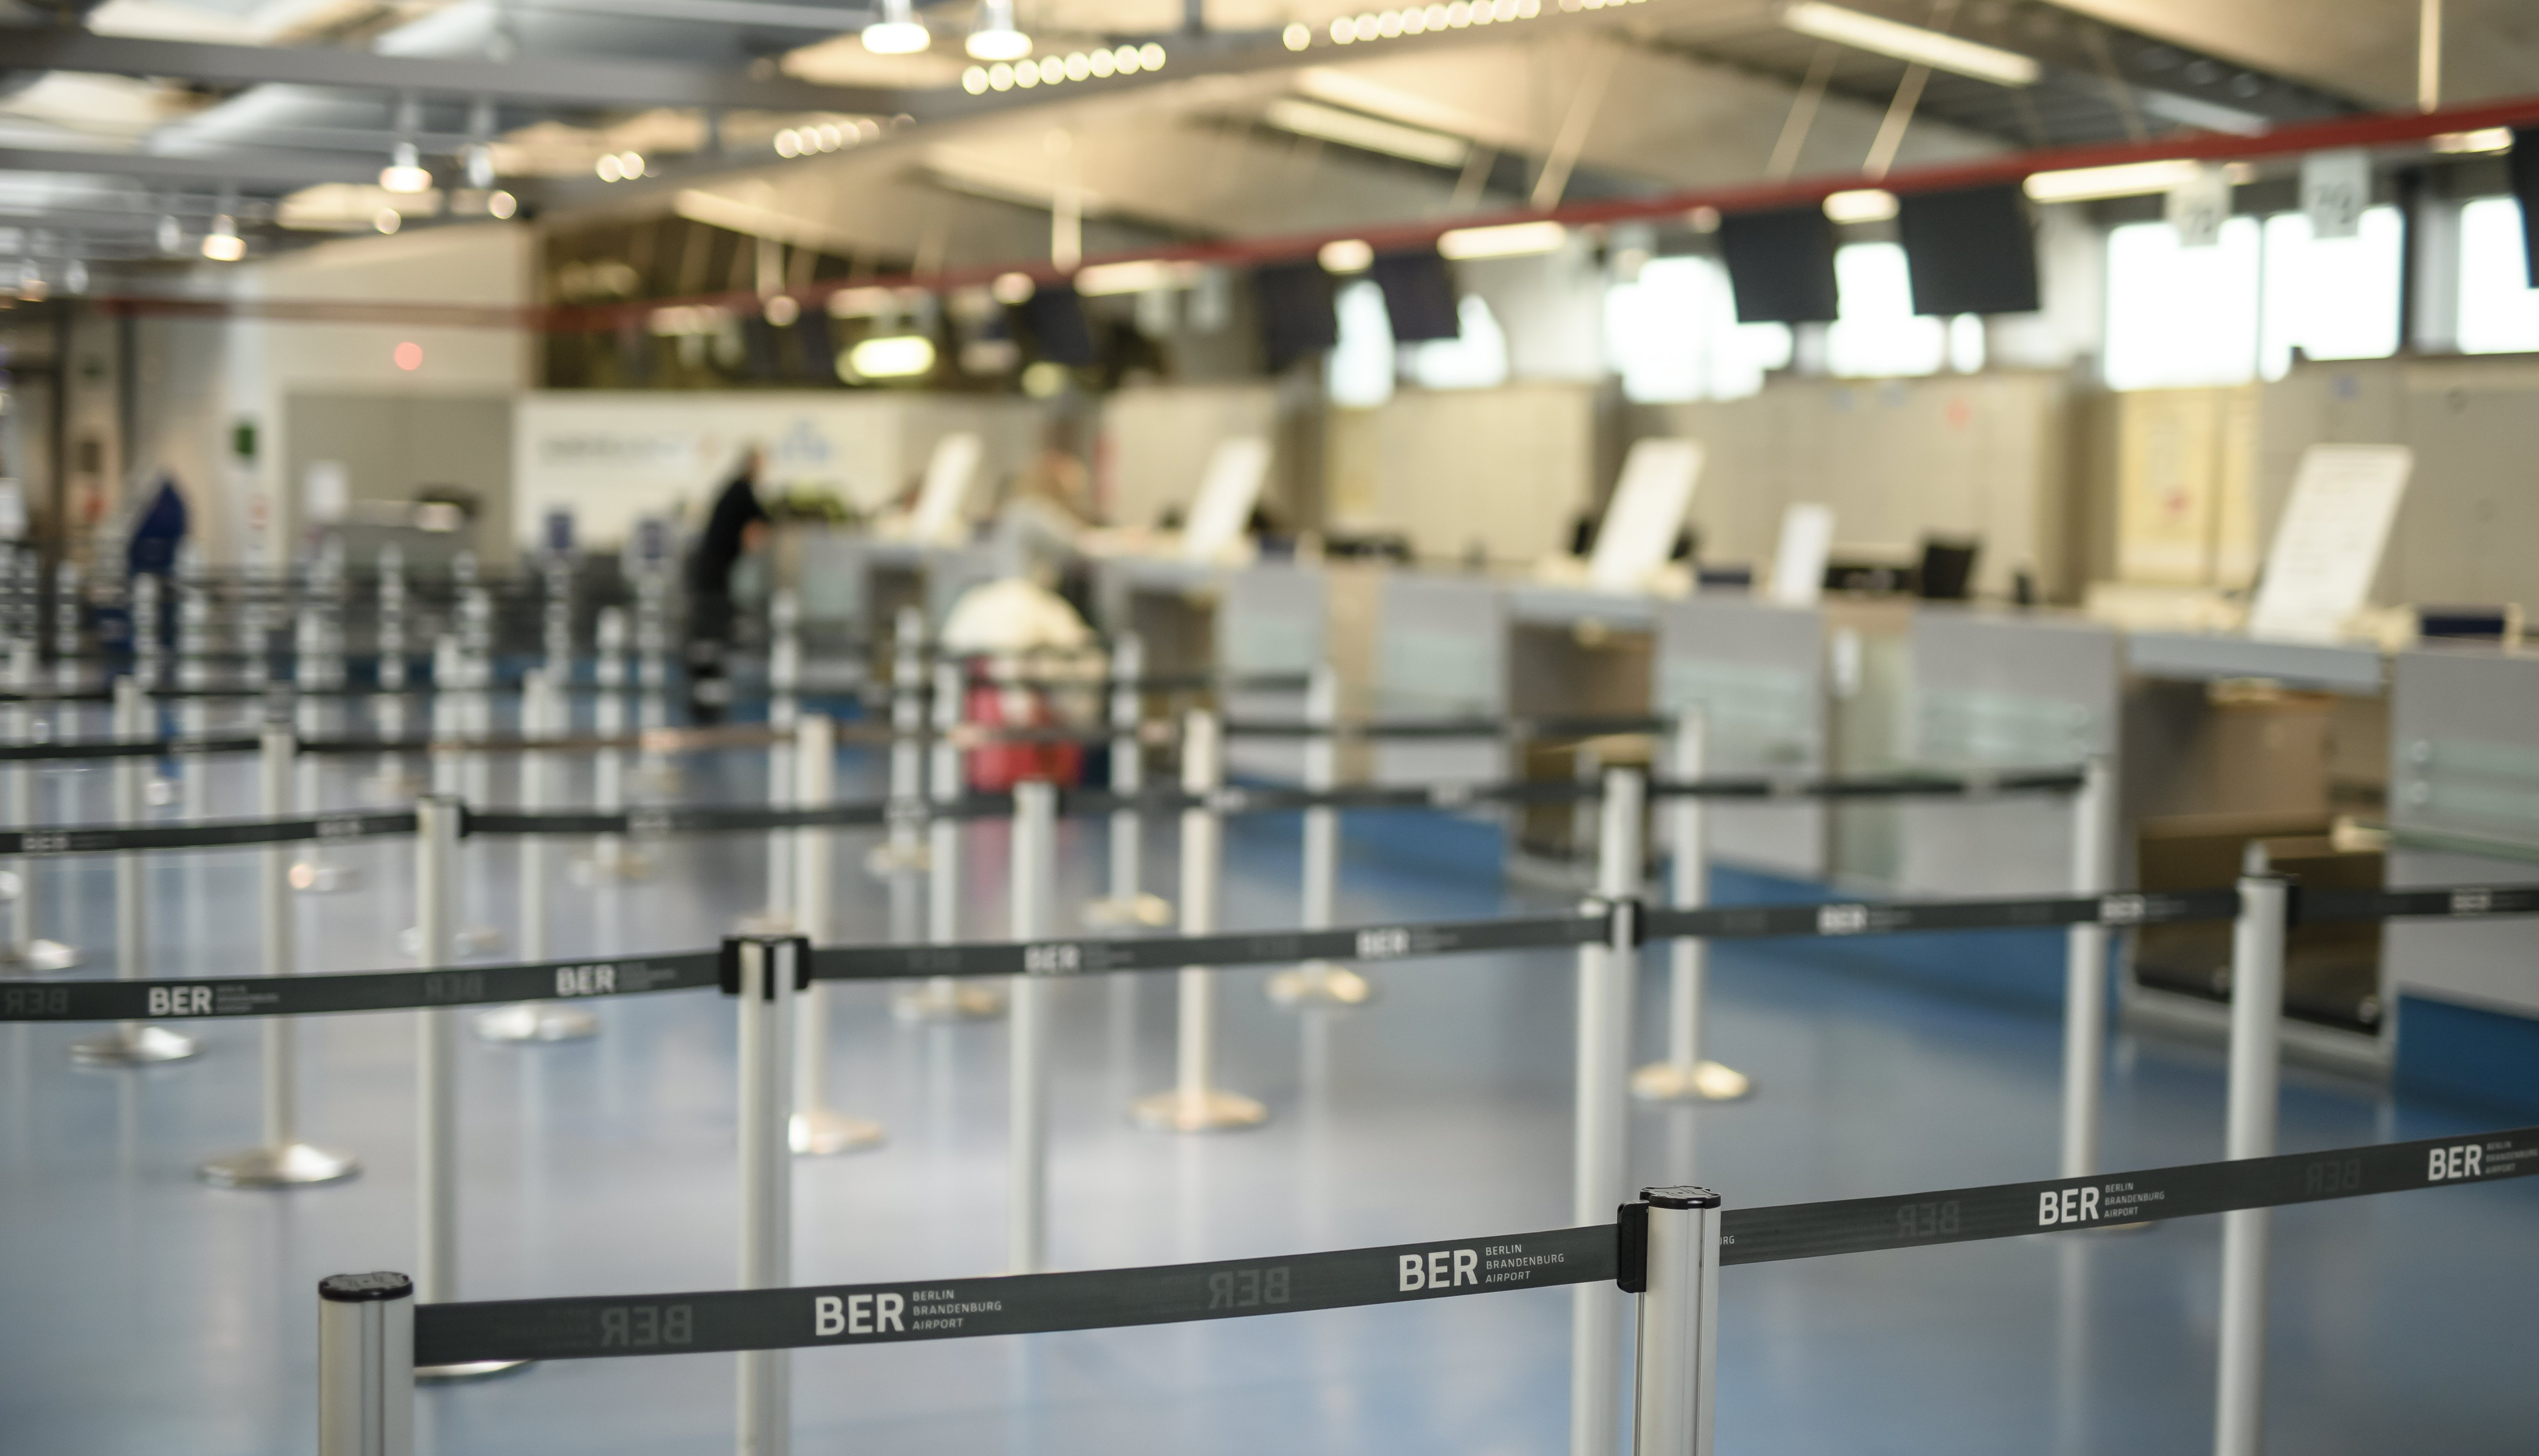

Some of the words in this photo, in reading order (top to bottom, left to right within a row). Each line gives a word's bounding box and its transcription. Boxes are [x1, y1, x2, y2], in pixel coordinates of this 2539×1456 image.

[556, 964, 615, 997] BER
[148, 986, 212, 1016] BER
[2428, 1144, 2482, 1181] BER
[2105, 1183, 2133, 1193] BERLIN
[2104, 1191, 2164, 1206] BRANDENBURG
[2039, 1187, 2099, 1226] BER
[2104, 1206, 2138, 1218] AIRPORT
[1485, 1244, 1522, 1256] BERLIN
[1486, 1253, 1565, 1270] BRANDENBURG
[1399, 1249, 1478, 1292] BER
[1485, 1271, 1531, 1283] AIRPORT
[913, 1289, 954, 1301] BERLIN
[815, 1293, 905, 1336] BER
[913, 1301, 1002, 1316] BRANDENBURG
[912, 1318, 964, 1331] AIRPORT
